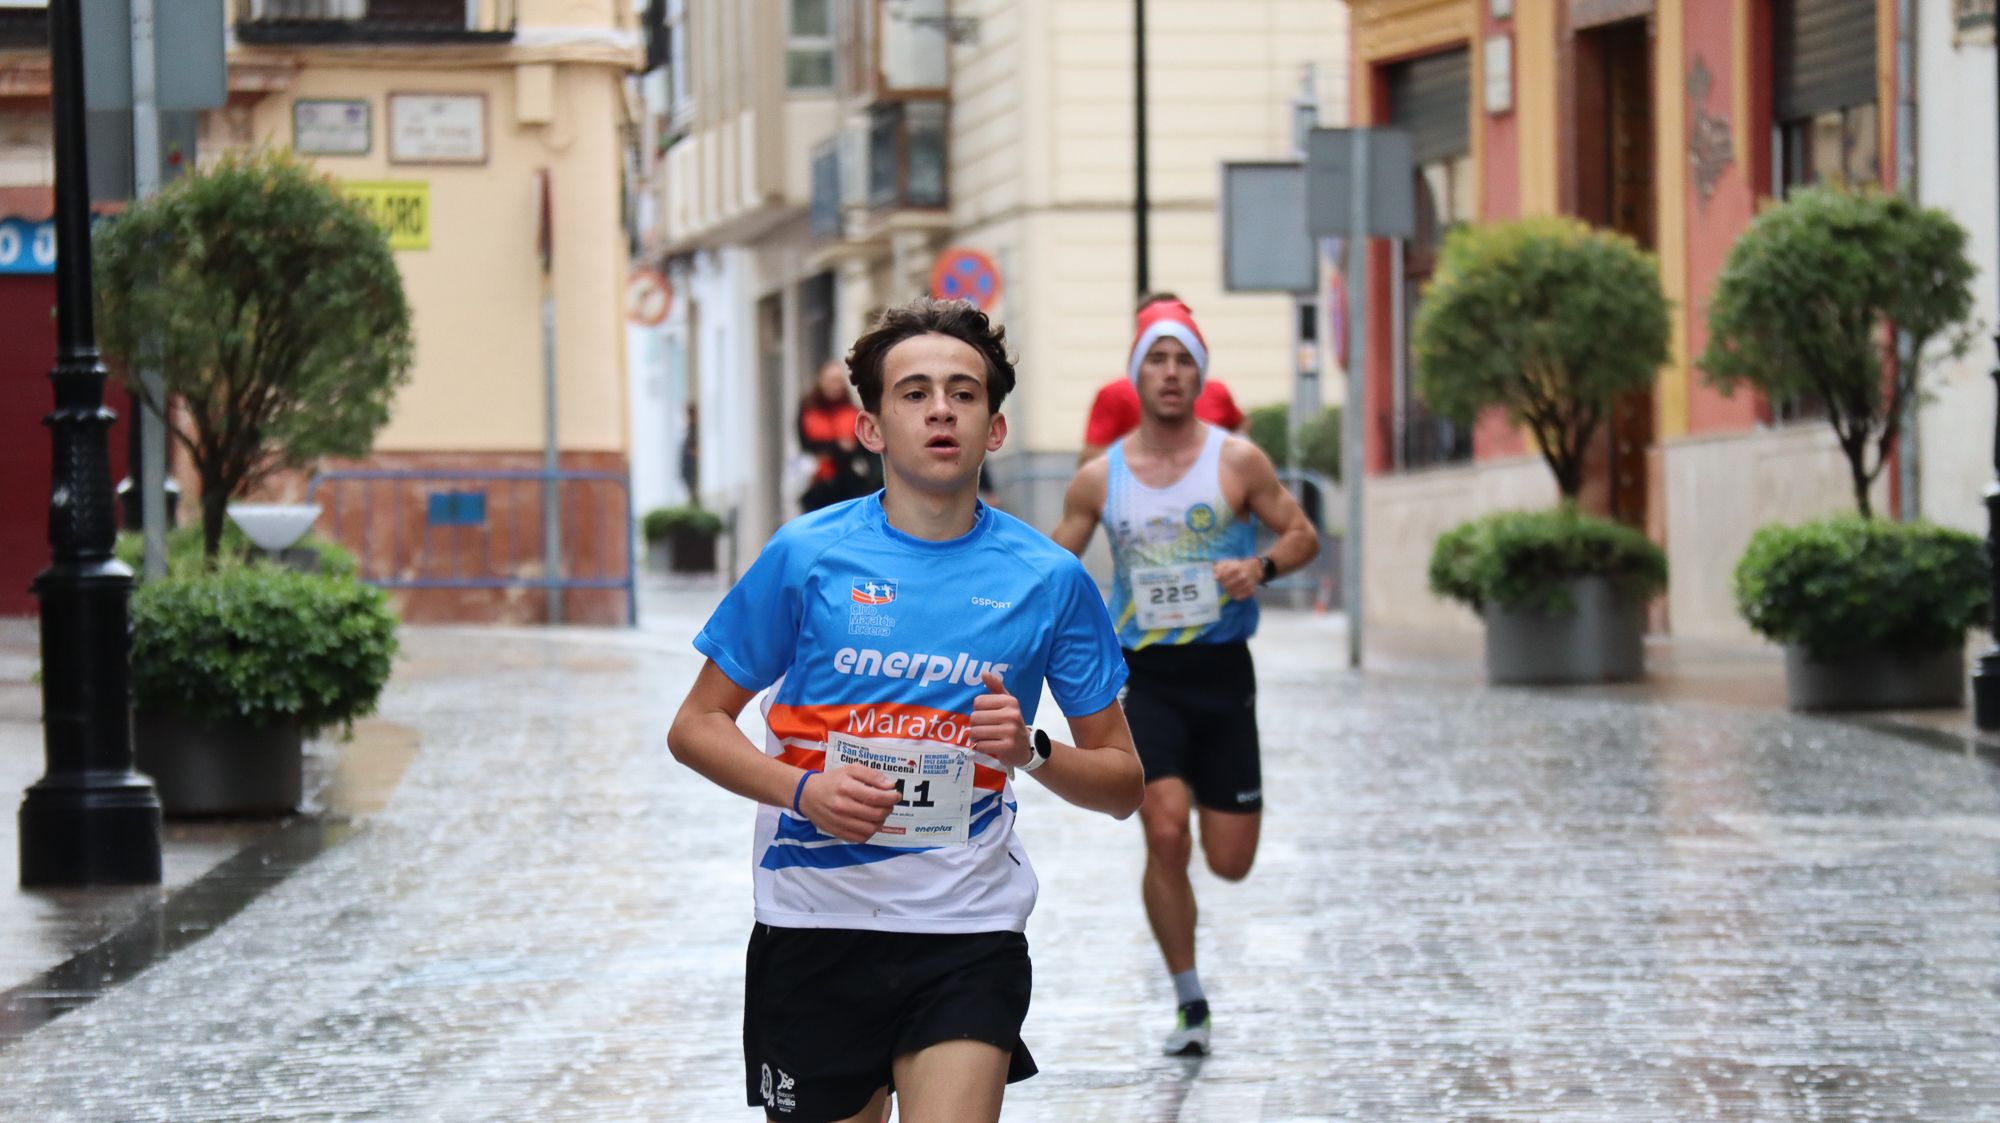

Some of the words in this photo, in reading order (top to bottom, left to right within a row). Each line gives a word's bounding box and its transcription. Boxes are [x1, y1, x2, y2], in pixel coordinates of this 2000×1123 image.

[1150, 584, 1199, 605] 225
[971, 596, 1012, 609] GSPORT
[850, 604, 877, 615] Club
[849, 614, 896, 627] Maratón
[848, 624, 891, 636] Lucena
[833, 647, 1009, 688] enerplus
[842, 745, 857, 757] San
[858, 749, 897, 764] Silvestre
[870, 760, 882, 770] de
[882, 762, 915, 774] Lucena
[914, 825, 953, 834] enerplus
